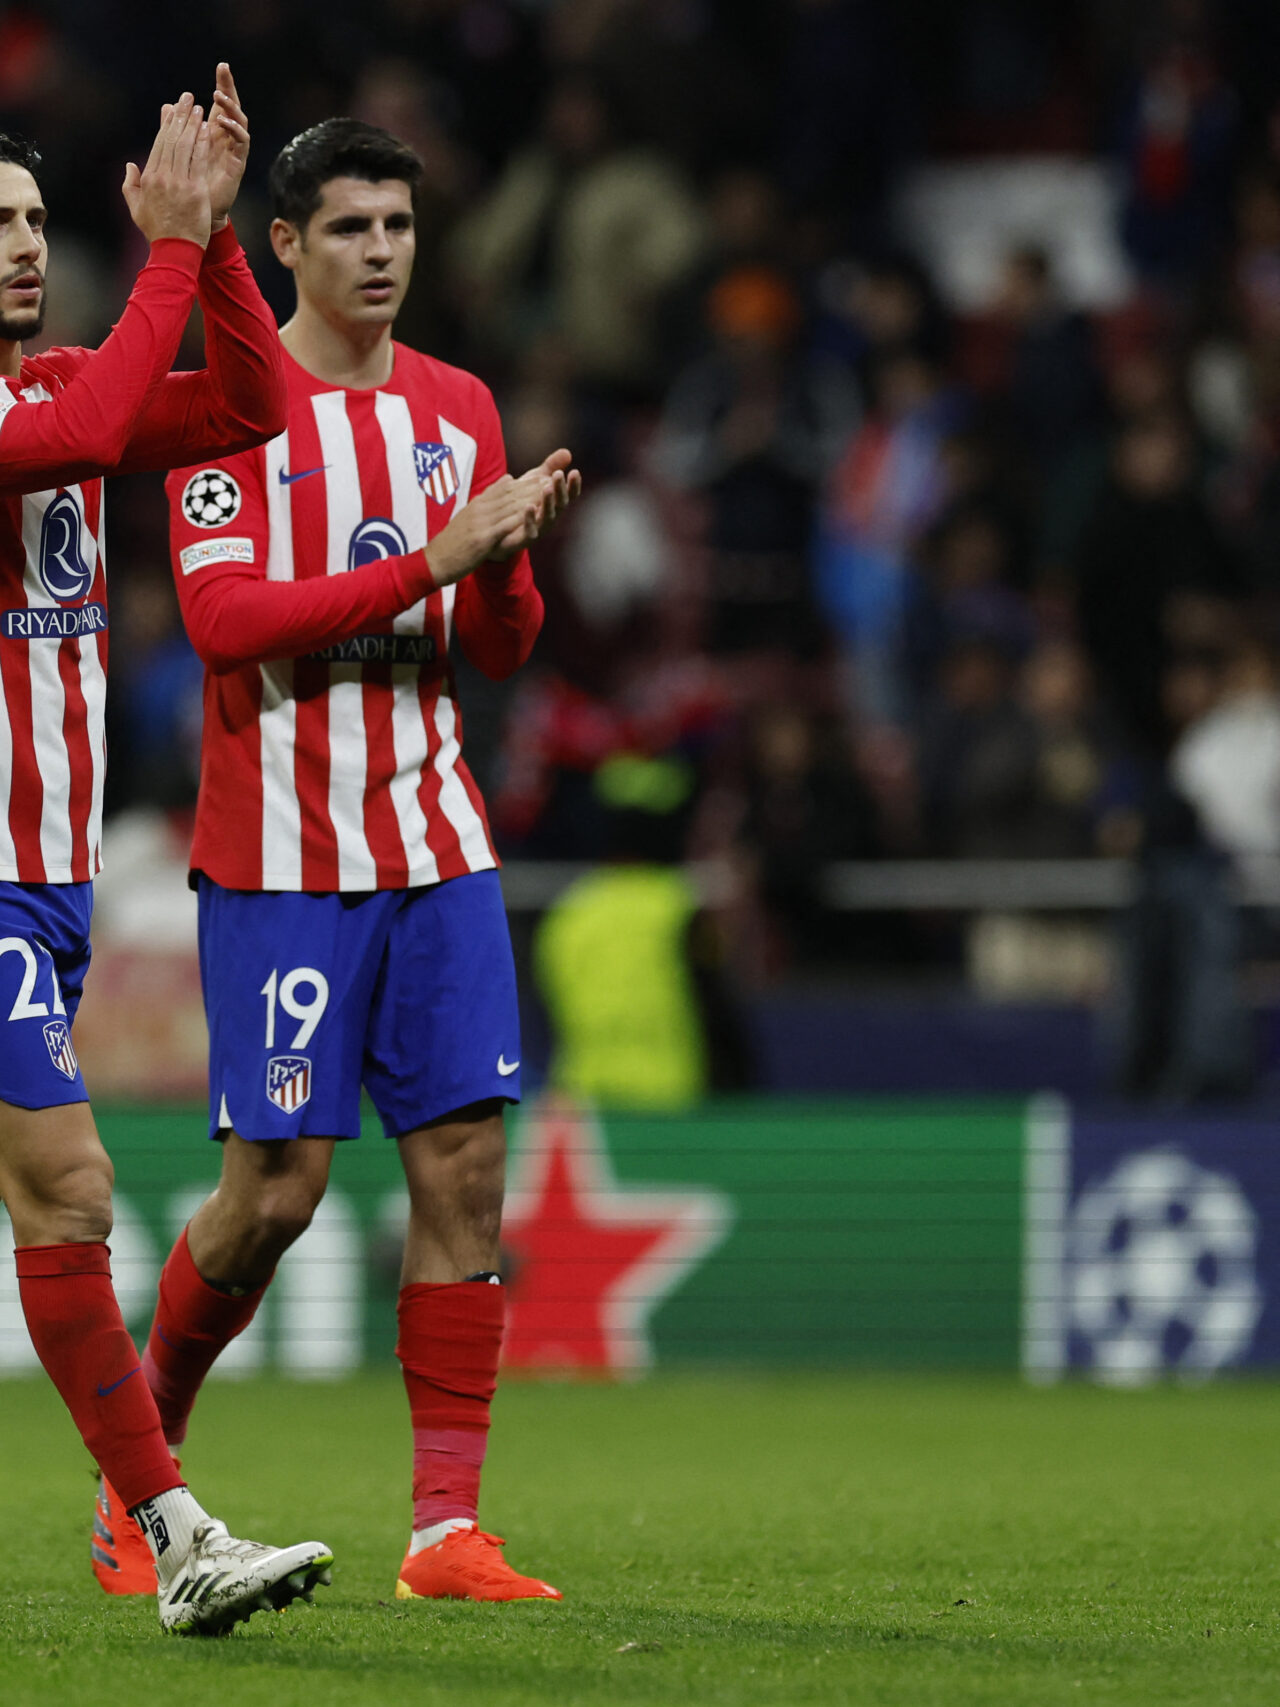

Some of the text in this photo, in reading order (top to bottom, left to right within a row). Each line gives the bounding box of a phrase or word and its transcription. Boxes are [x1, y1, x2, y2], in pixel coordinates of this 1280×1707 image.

[81, 605, 106, 632] AIR
[310, 636, 398, 661] IYADH
[260, 967, 329, 1050] 19
